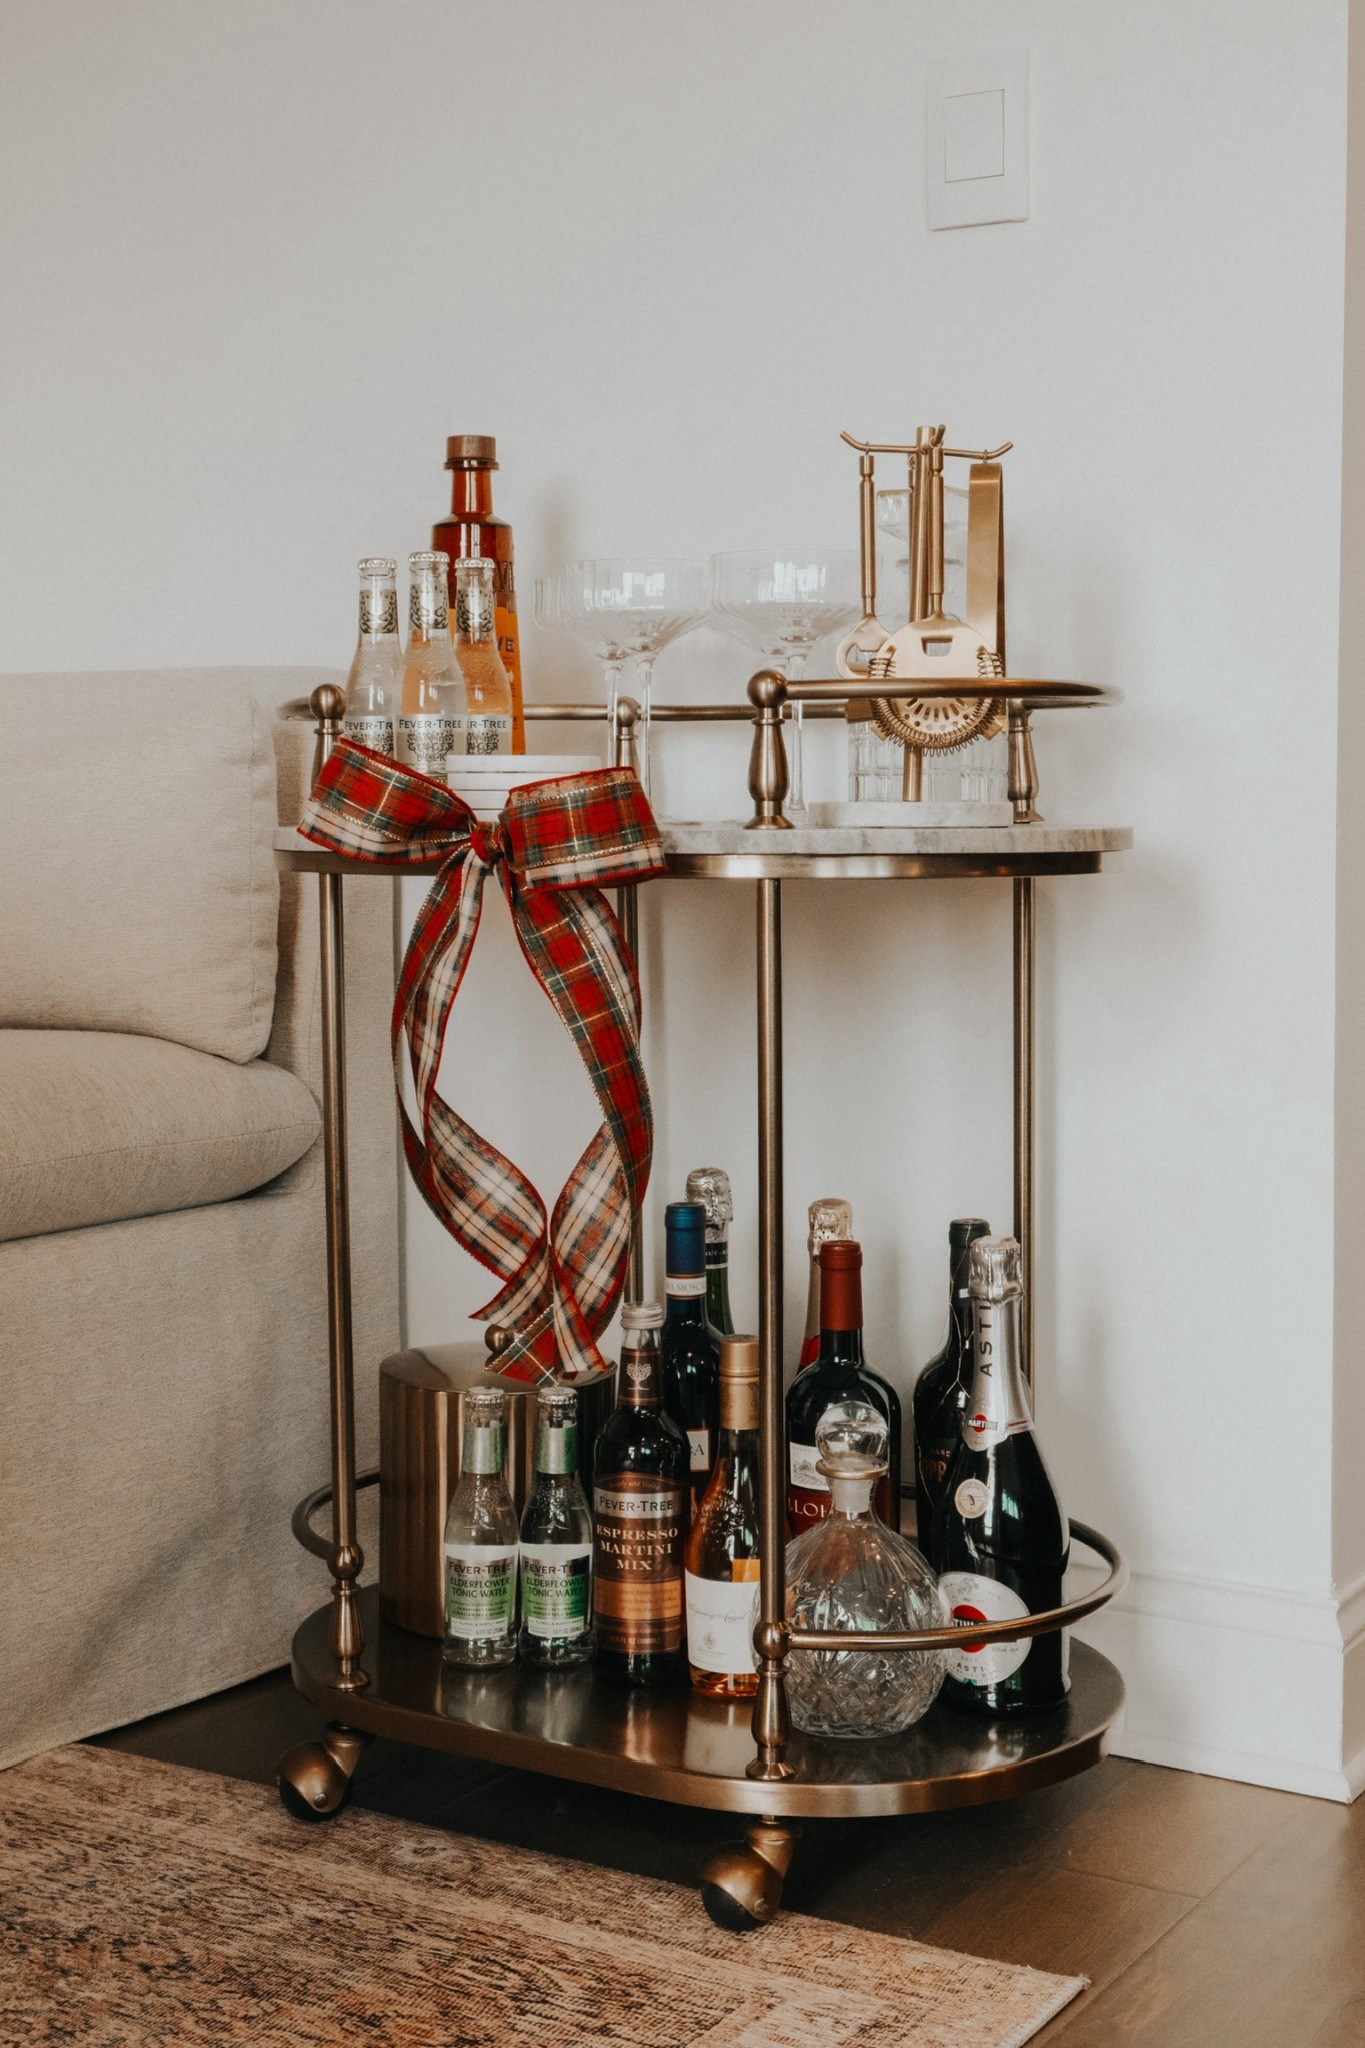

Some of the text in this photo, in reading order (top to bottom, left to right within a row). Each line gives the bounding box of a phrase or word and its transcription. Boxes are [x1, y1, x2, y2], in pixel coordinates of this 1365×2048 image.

[344, 720, 393, 731] FEVER-TR
[399, 719, 463, 729] FEVER-TREE
[467, 719, 507, 729] R-TREE
[407, 741, 455, 752] GINGER
[467, 740, 500, 752] NGER
[978, 1305, 993, 1378] ASTI
[967, 1418, 998, 1431] MARTINI
[599, 1496, 673, 1512] FEVER-TREE
[794, 1498, 828, 1519] LOH
[596, 1524, 679, 1541] ESPRESSO
[600, 1540, 673, 1556] MARTINI
[448, 1561, 512, 1576] FEVER-TREE
[616, 1559, 652, 1571] MIX
[450, 1576, 511, 1589] ELDERFLOWER
[526, 1576, 587, 1589] ELDERFLOWER
[452, 1587, 508, 1598] TONIC WATER
[528, 1586, 584, 1598] TONIC WATER
[955, 1662, 985, 1673] ASTI
